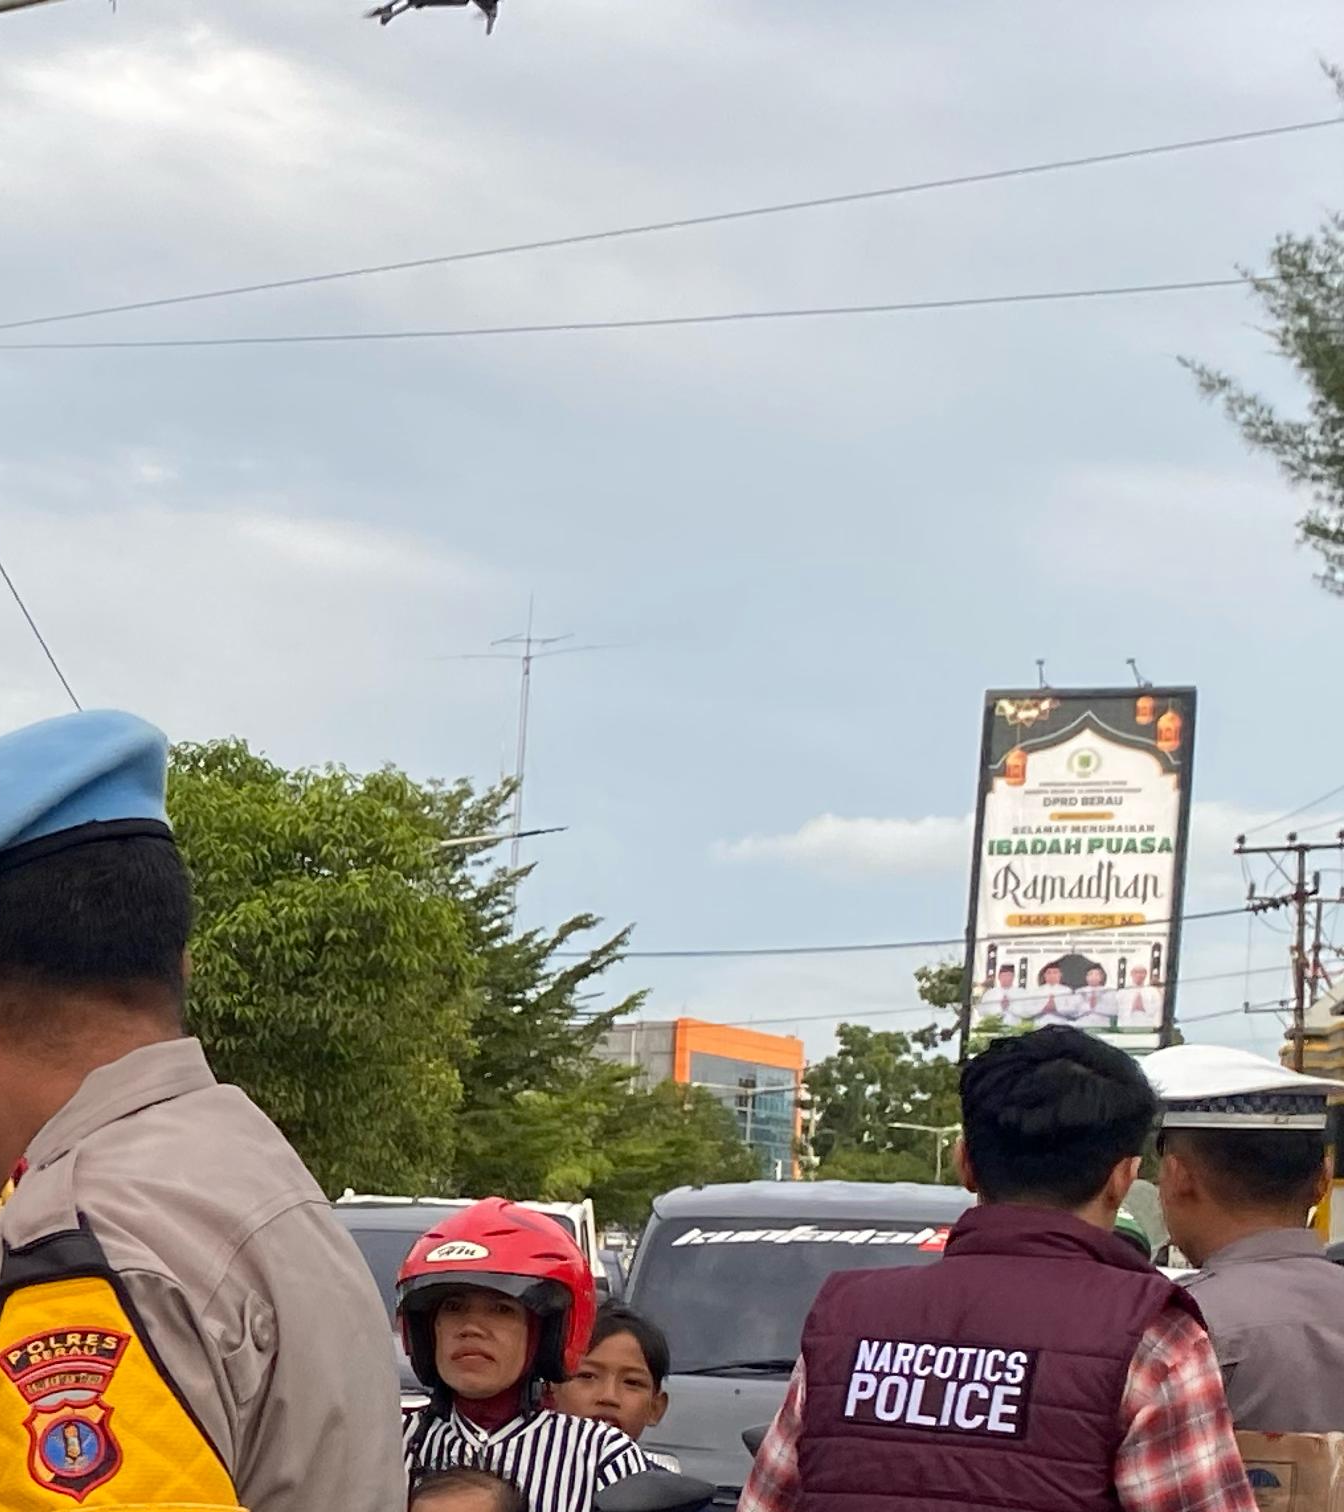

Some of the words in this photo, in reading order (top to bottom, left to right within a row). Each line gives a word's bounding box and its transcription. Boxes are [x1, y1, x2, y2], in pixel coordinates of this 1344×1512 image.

[1043, 796, 1078, 807] DPRD
[1081, 795, 1124, 806] BERAU
[1012, 826, 1068, 835] SELAMAT
[988, 838, 1081, 856] IBADAH
[1087, 837, 1173, 855] PUASA
[992, 860, 1163, 908] Ramadhan
[1018, 915, 1050, 926] 1446
[1055, 915, 1066, 925] H
[1080, 914, 1115, 925] 2025
[7, 1333, 119, 1365] POLRES
[29, 1345, 97, 1364] BERAU
[855, 1340, 1028, 1384] NARCOTICS
[844, 1372, 1022, 1433] POLICE
